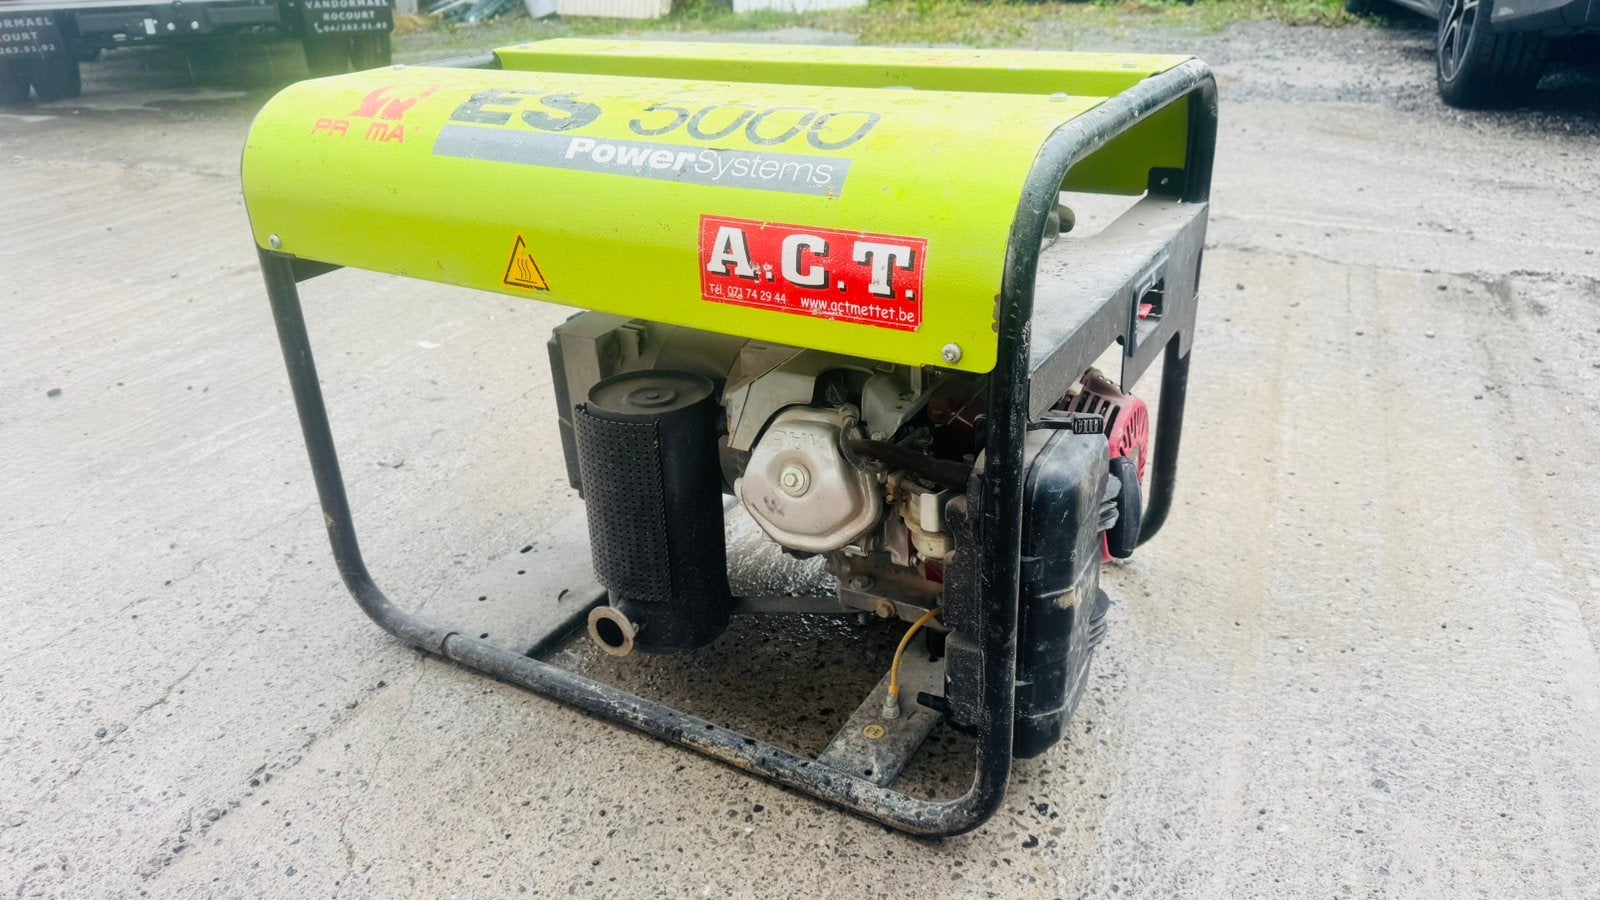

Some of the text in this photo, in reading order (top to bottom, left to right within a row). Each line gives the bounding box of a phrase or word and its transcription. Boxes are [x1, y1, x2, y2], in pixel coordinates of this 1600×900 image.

[0, 16, 53, 28] RMAEL
[322, 10, 376, 20] ROCOURT
[0, 31, 37, 42] OURT
[449, 88, 882, 151] ES 5000
[706, 225, 916, 301] A.C.T.
[727, 285, 744, 300] 071
[746, 288, 758, 300] 74
[760, 290, 772, 302] 29
[774, 292, 787, 304] 44
[801, 297, 915, 323] www.actmettet.be
